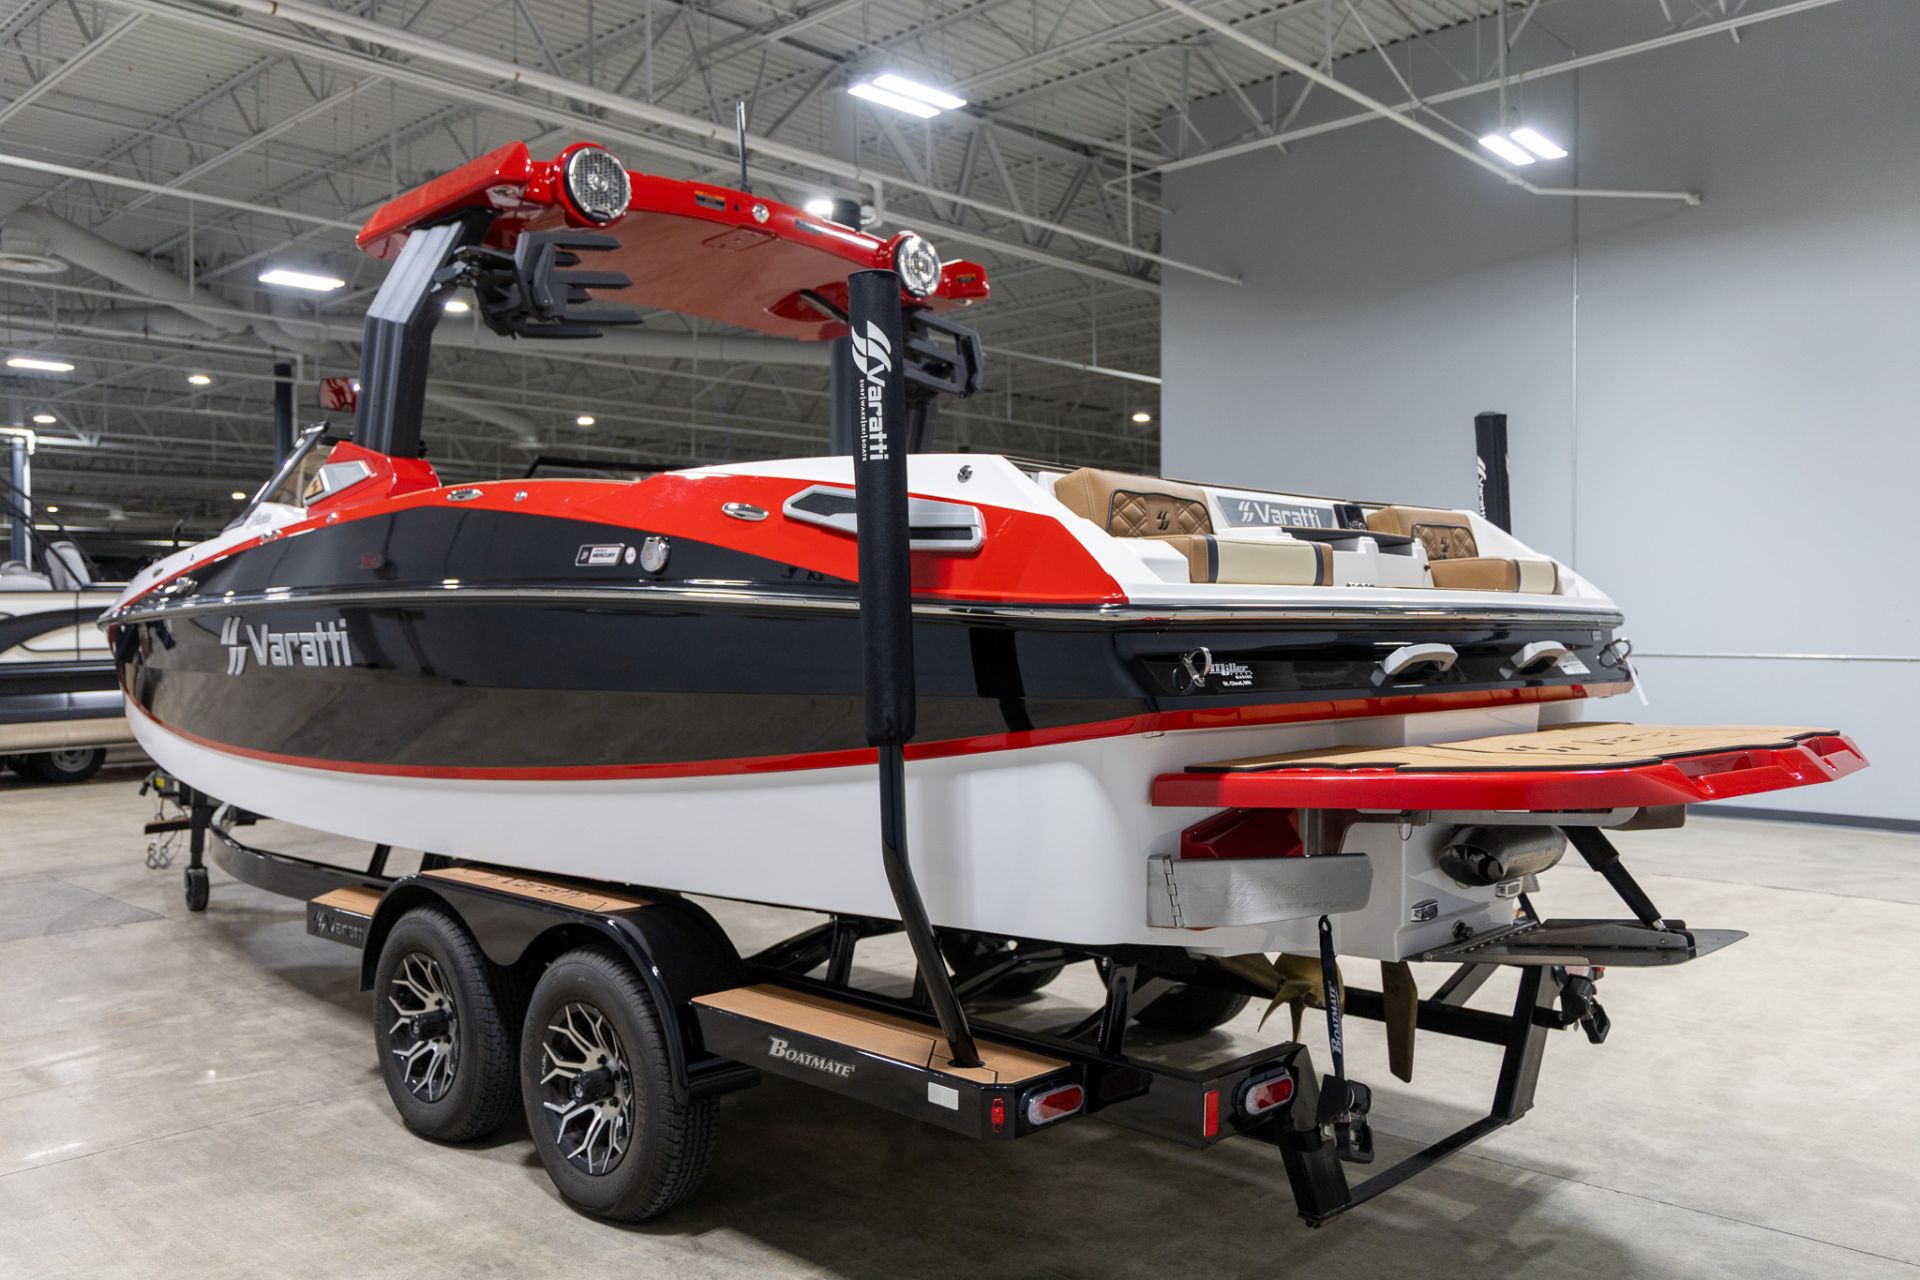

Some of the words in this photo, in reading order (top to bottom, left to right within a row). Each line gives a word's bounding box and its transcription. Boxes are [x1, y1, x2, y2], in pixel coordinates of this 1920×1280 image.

[866, 363, 889, 460] Varatti
[1253, 502, 1322, 529] Varatti
[246, 617, 352, 667] Varatti
